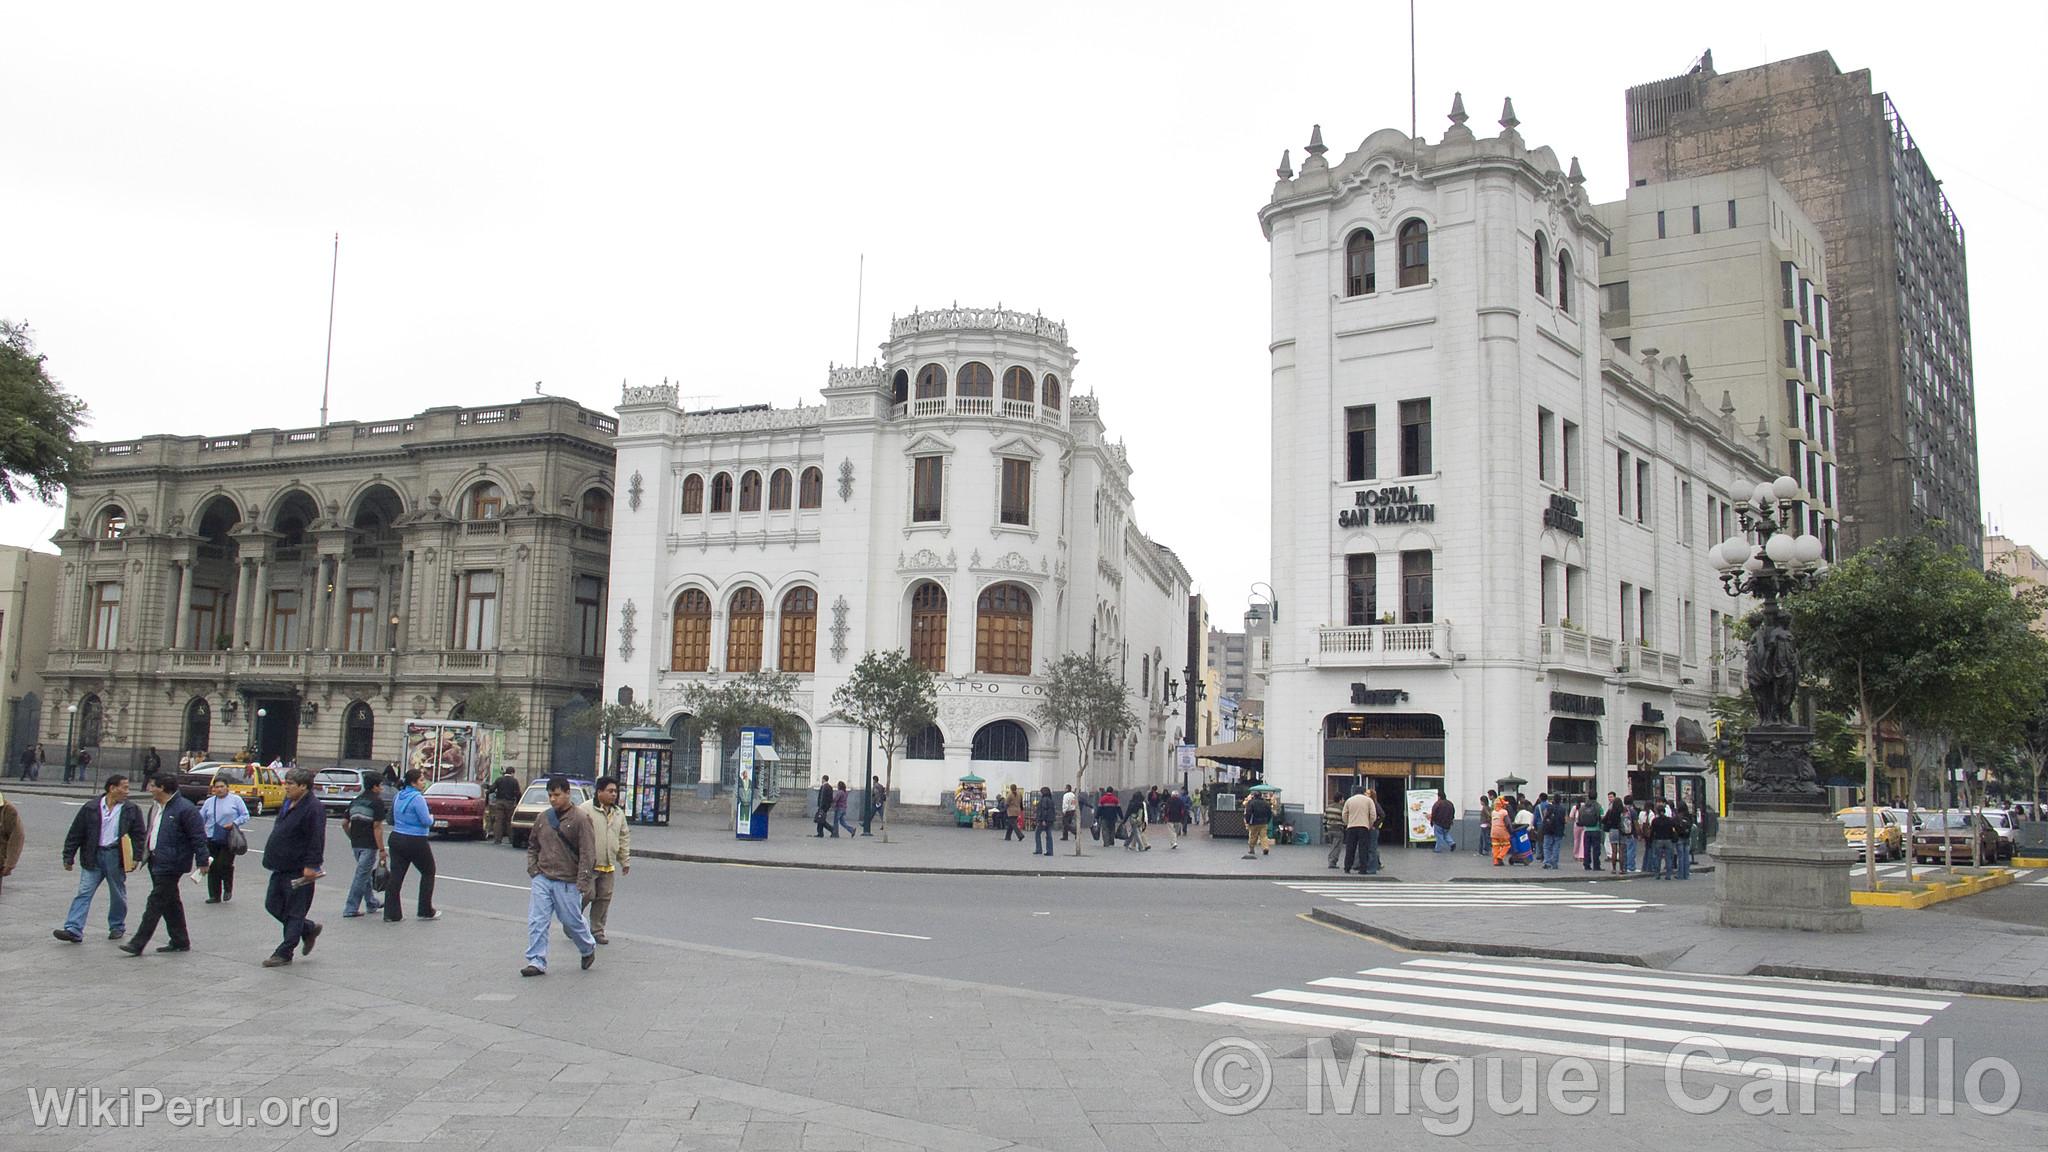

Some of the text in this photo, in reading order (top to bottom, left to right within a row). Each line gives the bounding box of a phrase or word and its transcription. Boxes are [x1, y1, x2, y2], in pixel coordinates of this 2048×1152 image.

[1355, 486, 1418, 506] HOSTAL
[1339, 504, 1435, 528] SAN MARTIN
[939, 682, 1043, 695] ATRO CO
